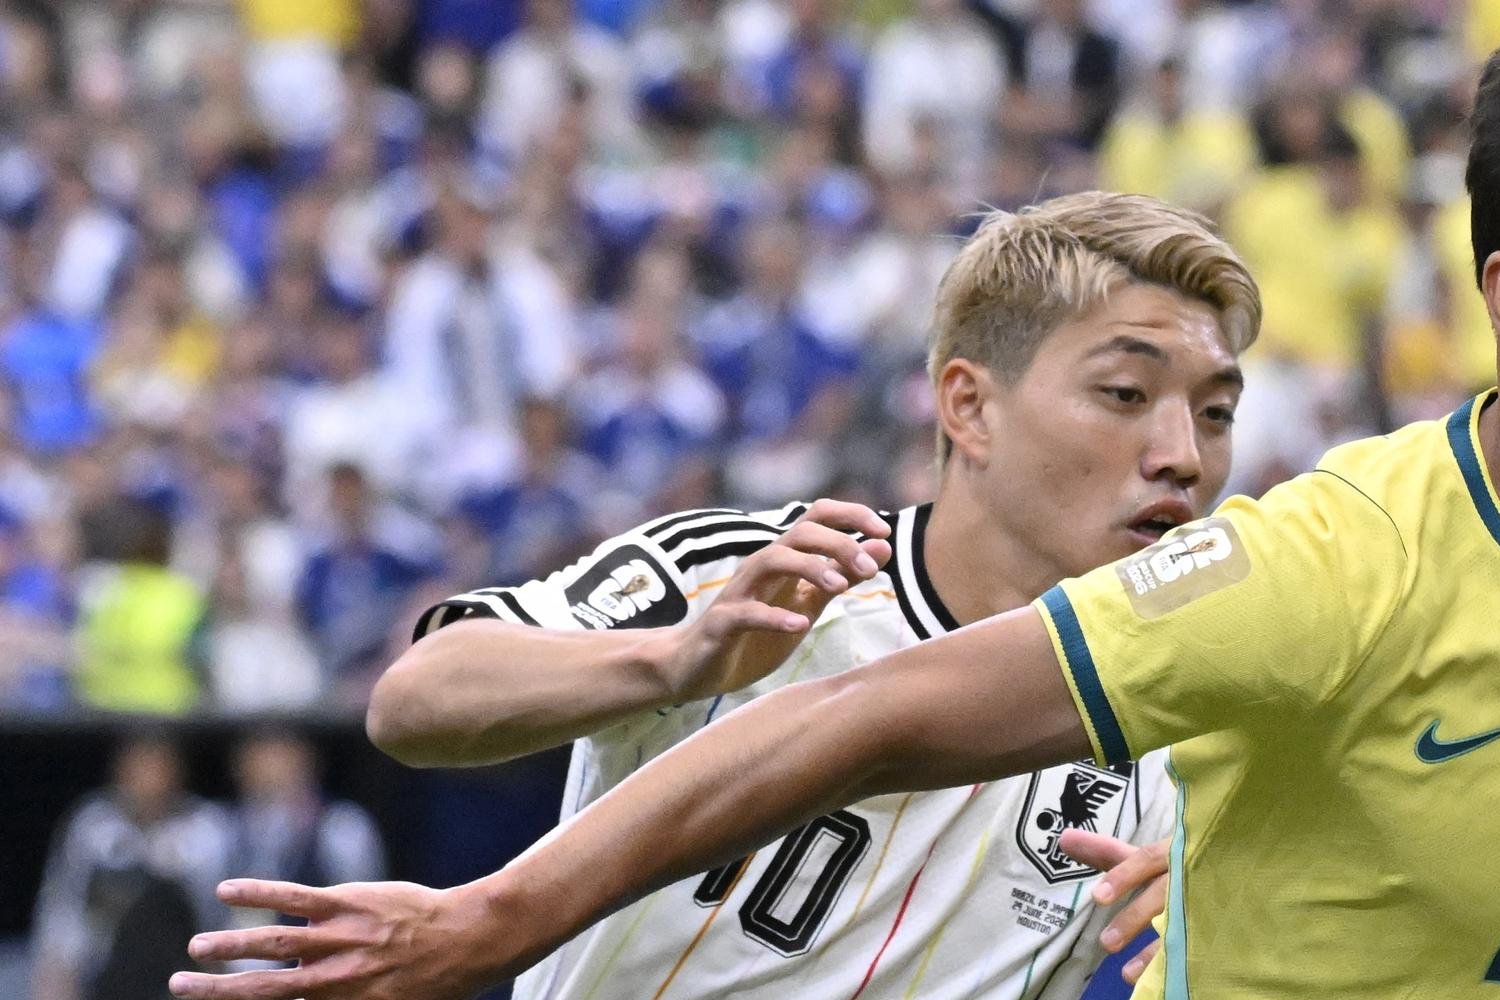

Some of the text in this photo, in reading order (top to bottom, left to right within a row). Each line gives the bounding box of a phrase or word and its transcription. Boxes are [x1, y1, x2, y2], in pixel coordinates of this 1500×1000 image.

[1038, 898, 1049, 910] VS
[1016, 916, 1052, 935] HOUSTON
[1023, 905, 1044, 920] JUNE
[1044, 913, 1066, 928] 2026
